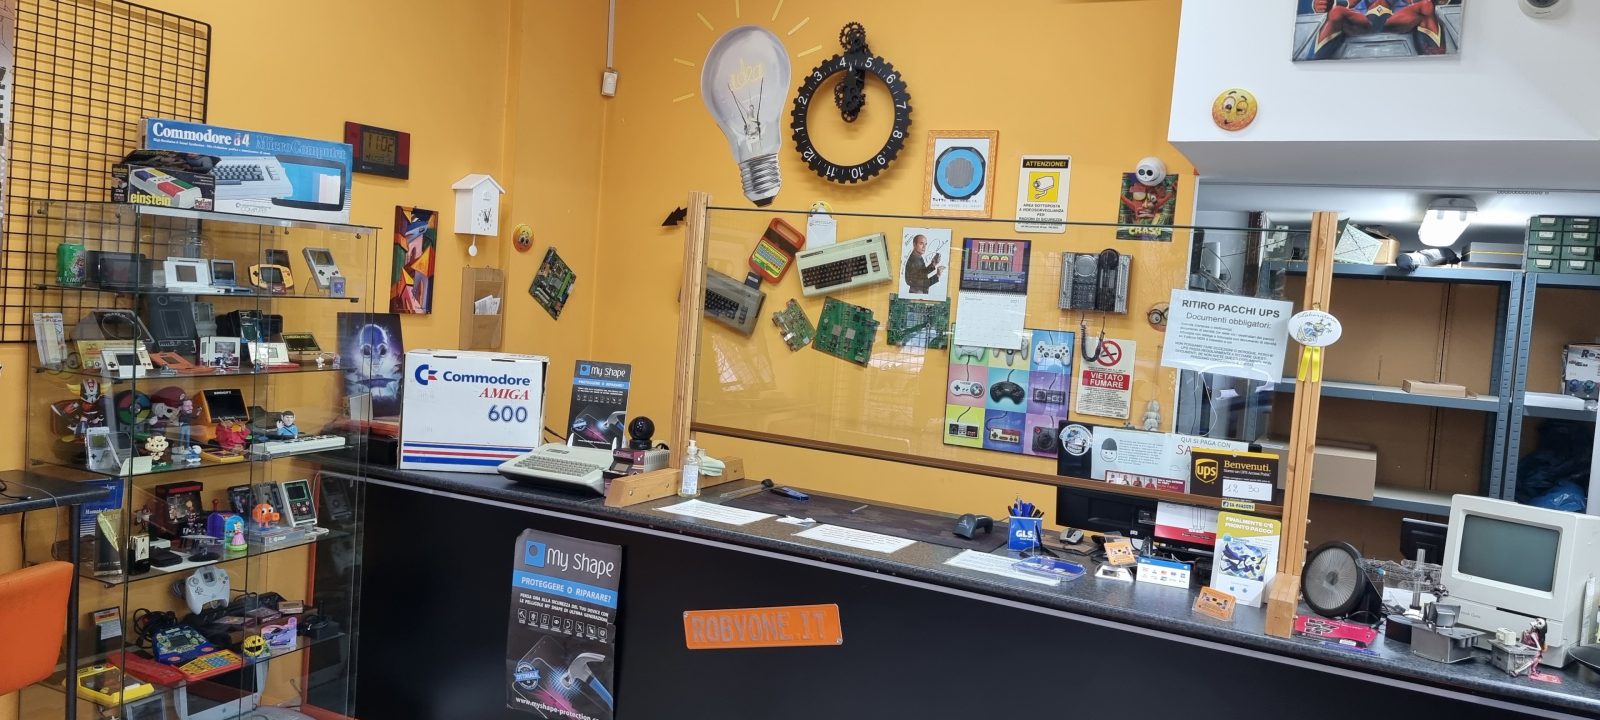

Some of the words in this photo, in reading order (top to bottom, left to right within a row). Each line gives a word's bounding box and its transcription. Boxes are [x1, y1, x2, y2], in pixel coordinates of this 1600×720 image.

[840, 57, 846, 66] 4
[865, 57, 873, 68] 5
[814, 71, 822, 81] 3
[886, 74, 896, 84] 6
[798, 96, 807, 105] 2
[152, 122, 232, 145] Commodore
[893, 130, 903, 138] 8
[803, 148, 816, 162] 12
[877, 154, 885, 164] 9
[826, 166, 836, 177] 11
[851, 167, 864, 178] 10
[130, 192, 172, 206] einstein
[1129, 226, 1162, 236] CRASH
[1182, 300, 1215, 310] RITIRO
[1218, 304, 1256, 315] PACCHI
[1259, 309, 1280, 318] UPS
[1186, 312, 1226, 323] Documenti
[1229, 318, 1271, 329] obbligatori:
[591, 366, 603, 377] My
[604, 367, 626, 378] Shape
[1091, 372, 1123, 381] VIETATO
[443, 371, 531, 386] Commodore
[1090, 379, 1123, 388] FUMARE
[478, 387, 530, 400] AMIGA
[488, 405, 528, 422] 600
[1224, 460, 1271, 472] Benvenuti.
[1197, 466, 1216, 479] ups
[1016, 530, 1033, 538] GLS
[546, 548, 568, 571] My
[573, 553, 614, 579] Shape
[521, 577, 564, 593] PROTEGGERE
[576, 587, 612, 603] RIPARARE?
